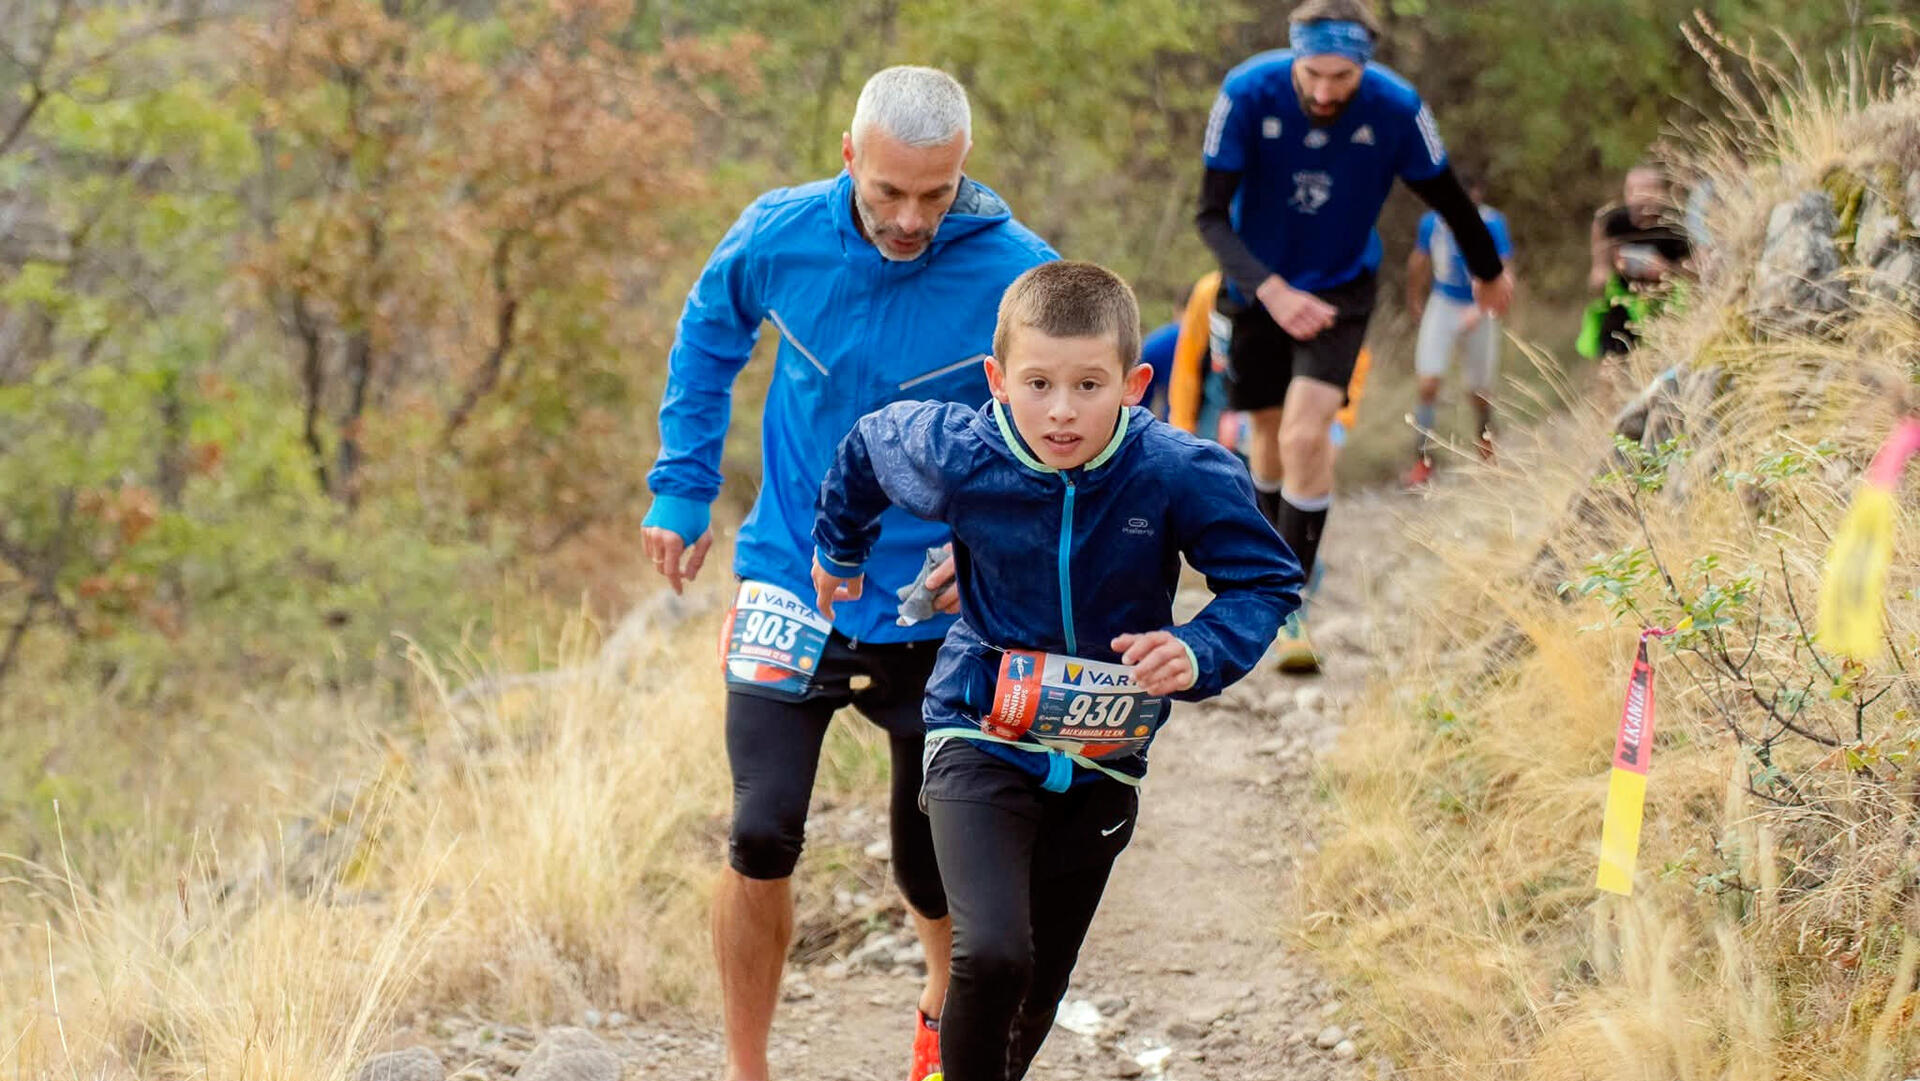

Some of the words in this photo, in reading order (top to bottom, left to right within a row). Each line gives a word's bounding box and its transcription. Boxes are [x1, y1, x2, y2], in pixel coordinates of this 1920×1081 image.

[764, 591, 816, 621] VARTA
[742, 611, 802, 650] 903
[1088, 670, 1136, 686] VAR
[1062, 694, 1135, 727] 930
